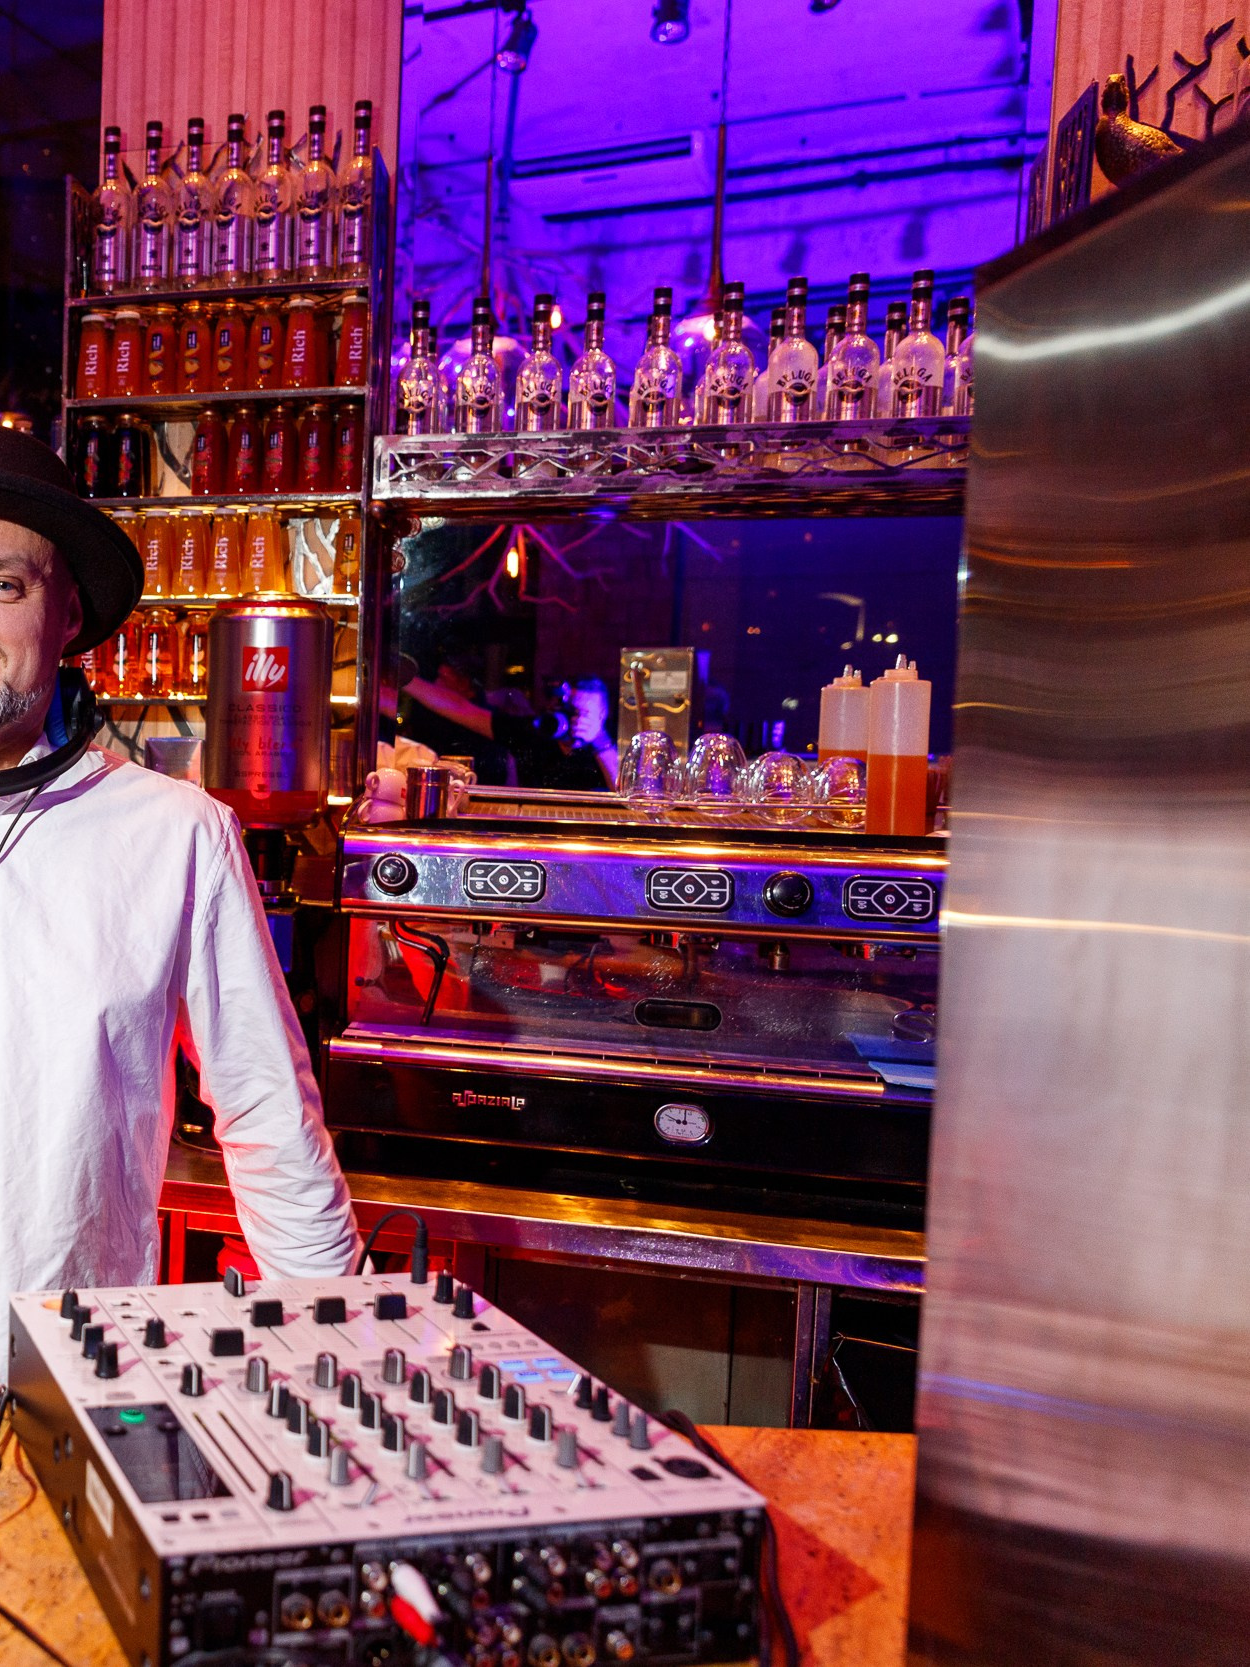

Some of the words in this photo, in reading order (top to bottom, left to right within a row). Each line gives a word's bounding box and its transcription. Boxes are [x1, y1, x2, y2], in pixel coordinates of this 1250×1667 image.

[117, 341, 131, 372] Rich
[292, 330, 306, 362] Rich
[349, 327, 363, 360] Rich
[85, 344, 98, 375] Rich
[776, 369, 815, 387] BELUGA
[831, 366, 873, 386] BELUGA
[894, 366, 933, 386] BELUGA
[146, 539, 158, 570] Rich
[181, 538, 194, 570] Rich
[215, 537, 229, 570] Rich
[252, 536, 265, 568] Rich
[245, 653, 286, 687] illy
